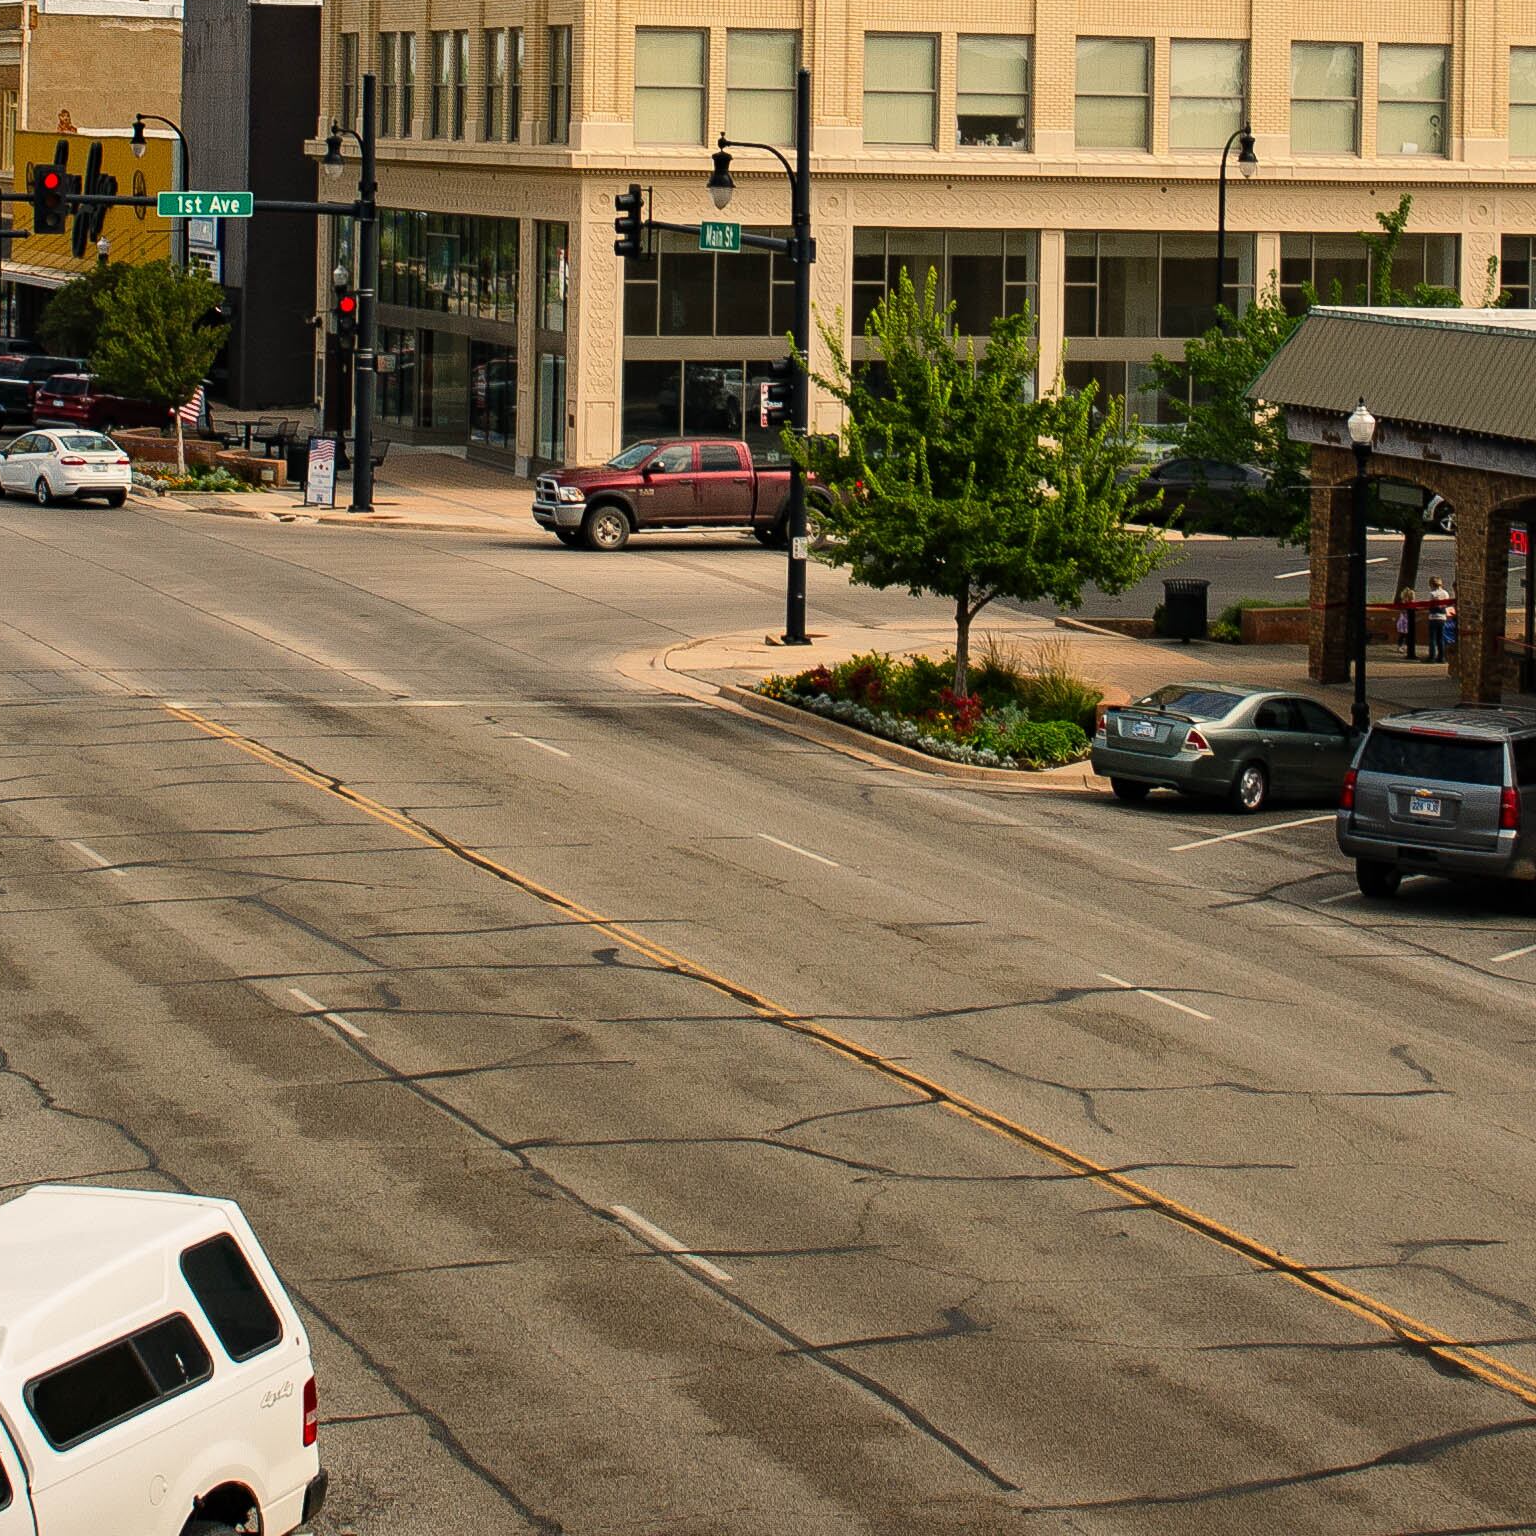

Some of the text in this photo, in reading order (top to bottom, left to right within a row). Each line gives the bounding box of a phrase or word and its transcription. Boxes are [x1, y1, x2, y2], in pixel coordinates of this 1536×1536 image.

[177, 196, 240, 214] 1st Ave
[705, 224, 734, 248] Main St
